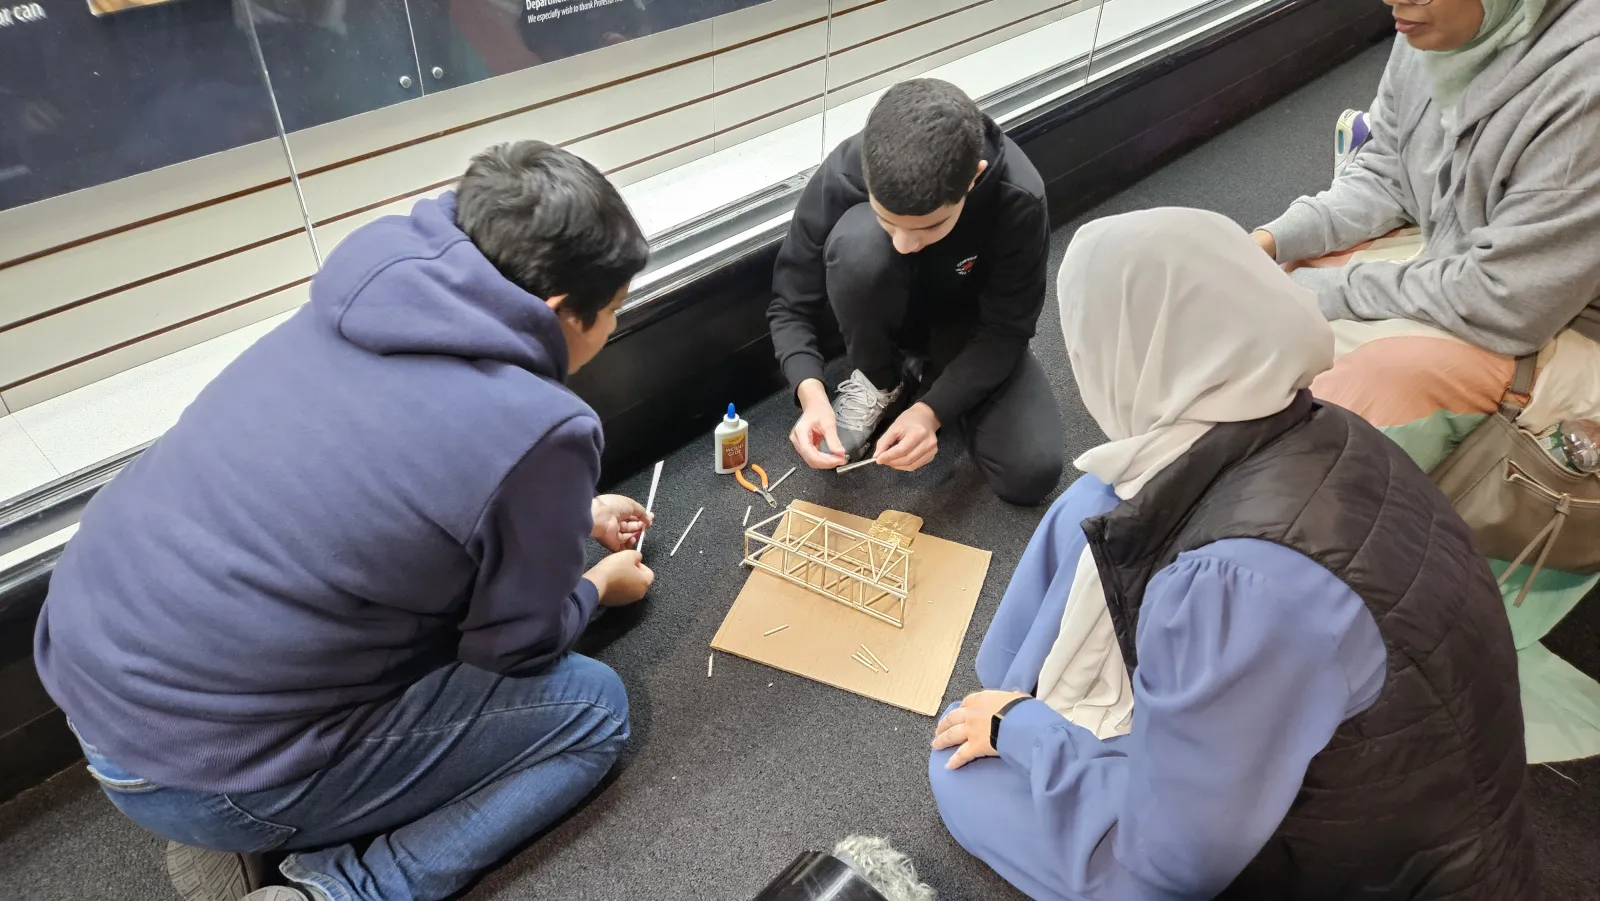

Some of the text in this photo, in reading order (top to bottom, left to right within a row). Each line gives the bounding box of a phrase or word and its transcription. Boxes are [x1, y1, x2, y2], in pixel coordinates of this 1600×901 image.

[13, 2, 47, 22] can
[527, 14, 536, 23] We
[536, 8, 560, 22] especially
[561, 5, 572, 15] wish
[573, 5, 579, 13] to
[579, 2, 593, 11] thank
